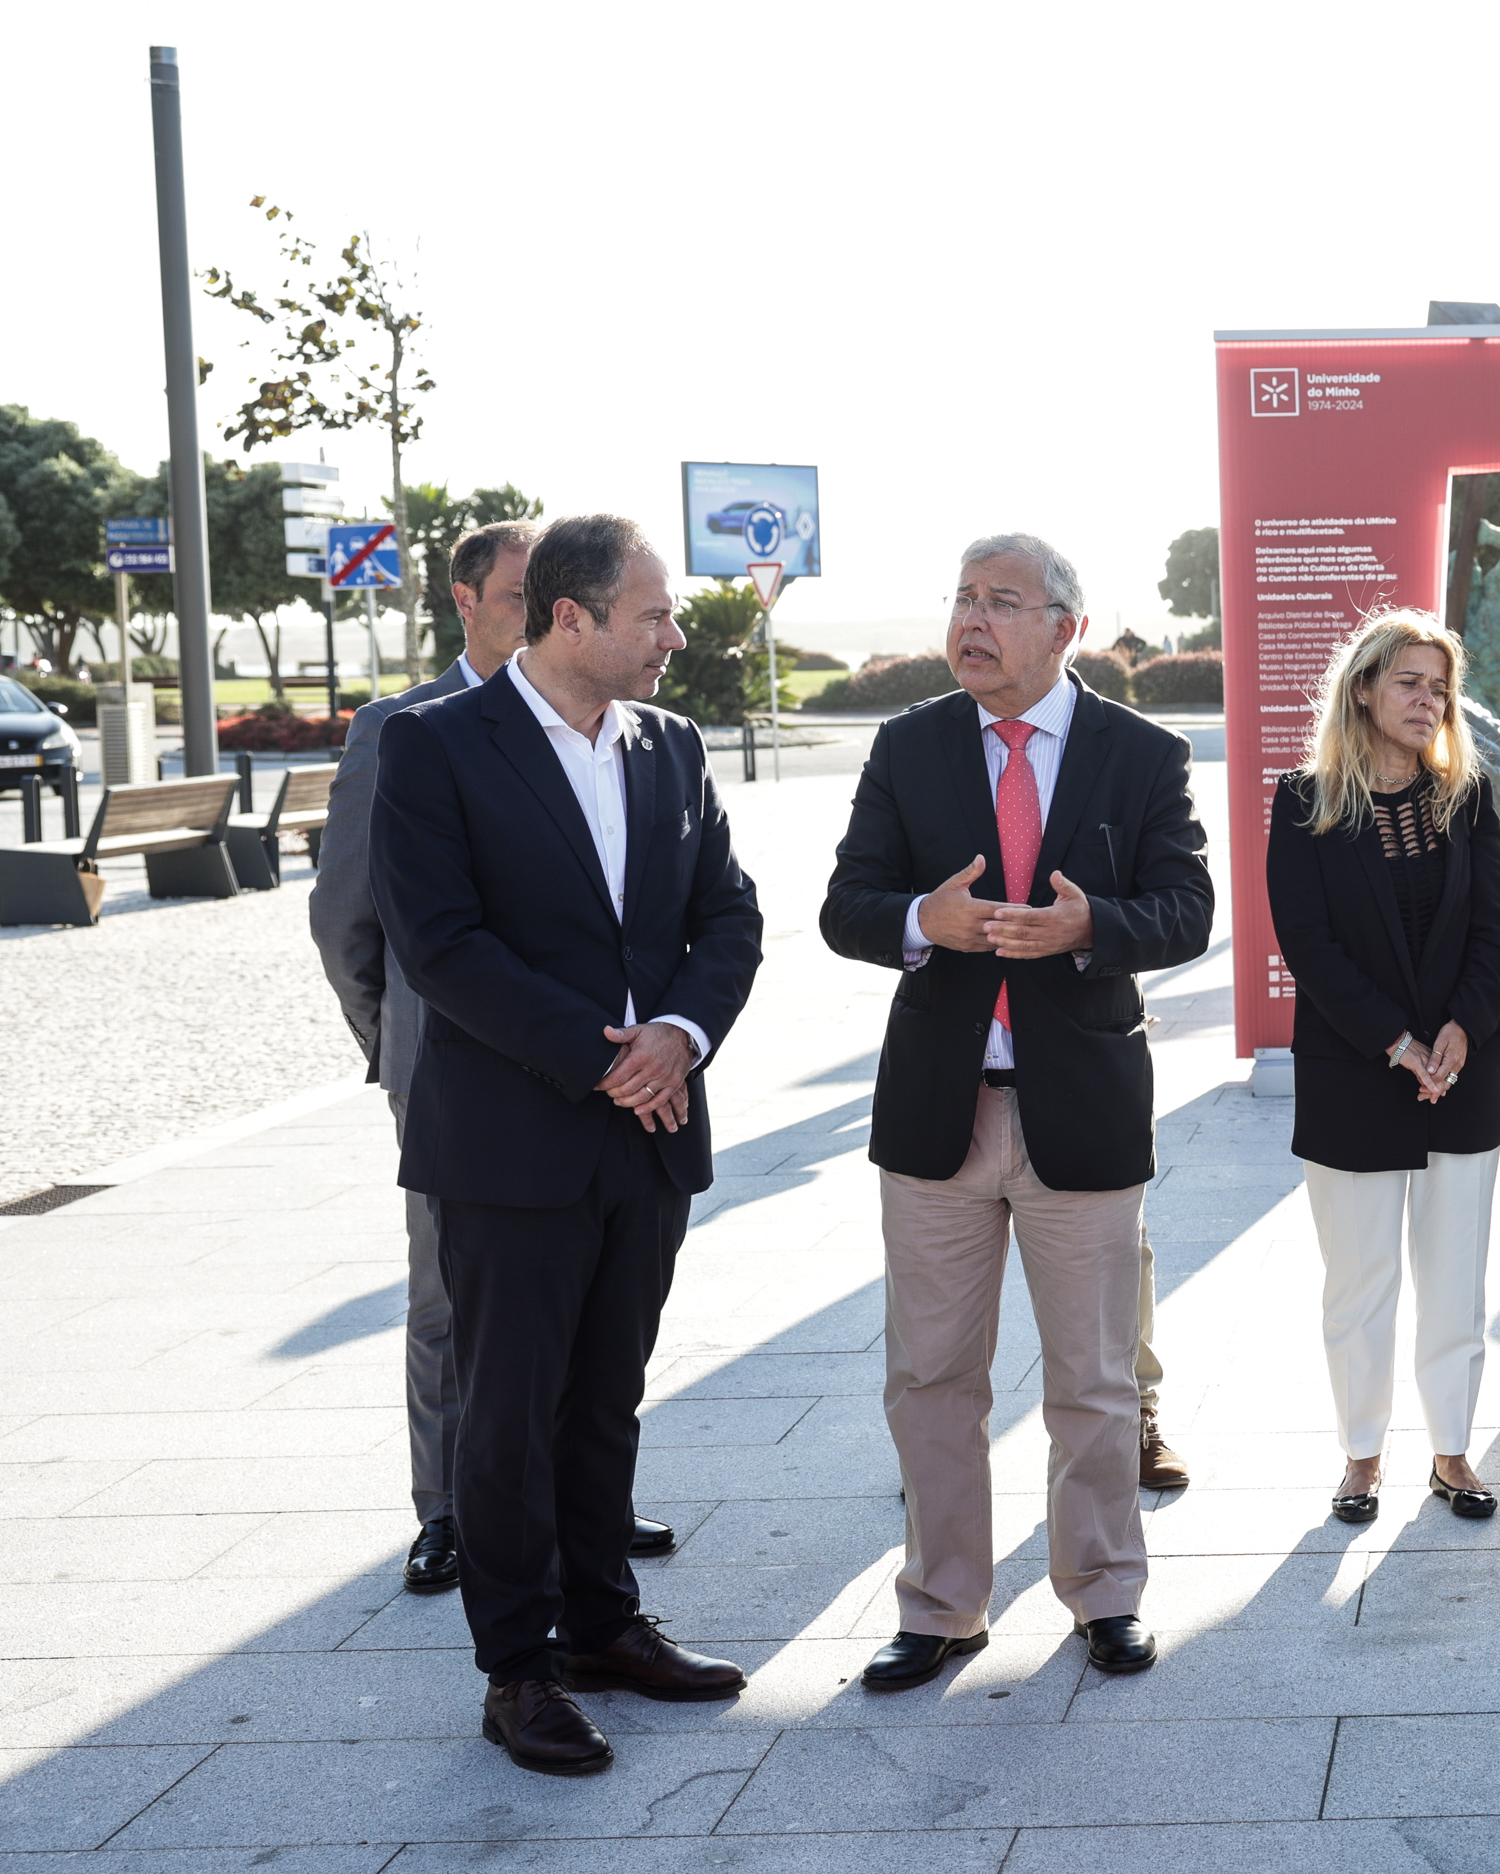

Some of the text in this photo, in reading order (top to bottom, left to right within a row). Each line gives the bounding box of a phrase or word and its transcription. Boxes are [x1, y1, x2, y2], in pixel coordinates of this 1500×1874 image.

[1306, 373, 1381, 384] Universidade
[1307, 386, 1360, 397] do Minho
[1308, 400, 1364, 411] 1974-2024
[1262, 518, 1298, 526] universo
[1299, 518, 1310, 526] de
[1311, 517, 1353, 526] atividades
[1354, 517, 1365, 525] da
[1366, 516, 1397, 525] UMinho
[1262, 528, 1278, 536] rico
[1286, 527, 1345, 535] multifacetado.
[1256, 545, 1372, 555] Deixamos aqui mais algumas
[1256, 555, 1302, 564] referências
[1303, 556, 1319, 564] que
[1268, 566, 1297, 574] campo
[1347, 564, 1358, 572] da
[1298, 574, 1314, 582] não
[1365, 573, 1376, 581] de
[1257, 592, 1333, 601] Unidades Culturais
[1258, 612, 1285, 620] Arquivo
[1286, 611, 1312, 619] Distrital
[1258, 622, 1293, 630] Biblioteca
[1294, 621, 1320, 629] Pública
[1258, 632, 1275, 640] Casa
[1259, 642, 1276, 650] Casa
[1295, 652, 1323, 660] Estudos
[1284, 662, 1316, 671] Nogueira
[1284, 673, 1306, 681] Virtual
[1260, 683, 1289, 691] Unidade
[1260, 704, 1299, 712] Unidades
[1261, 725, 1296, 733] Biblioteca
[1261, 736, 1279, 744] Casa
